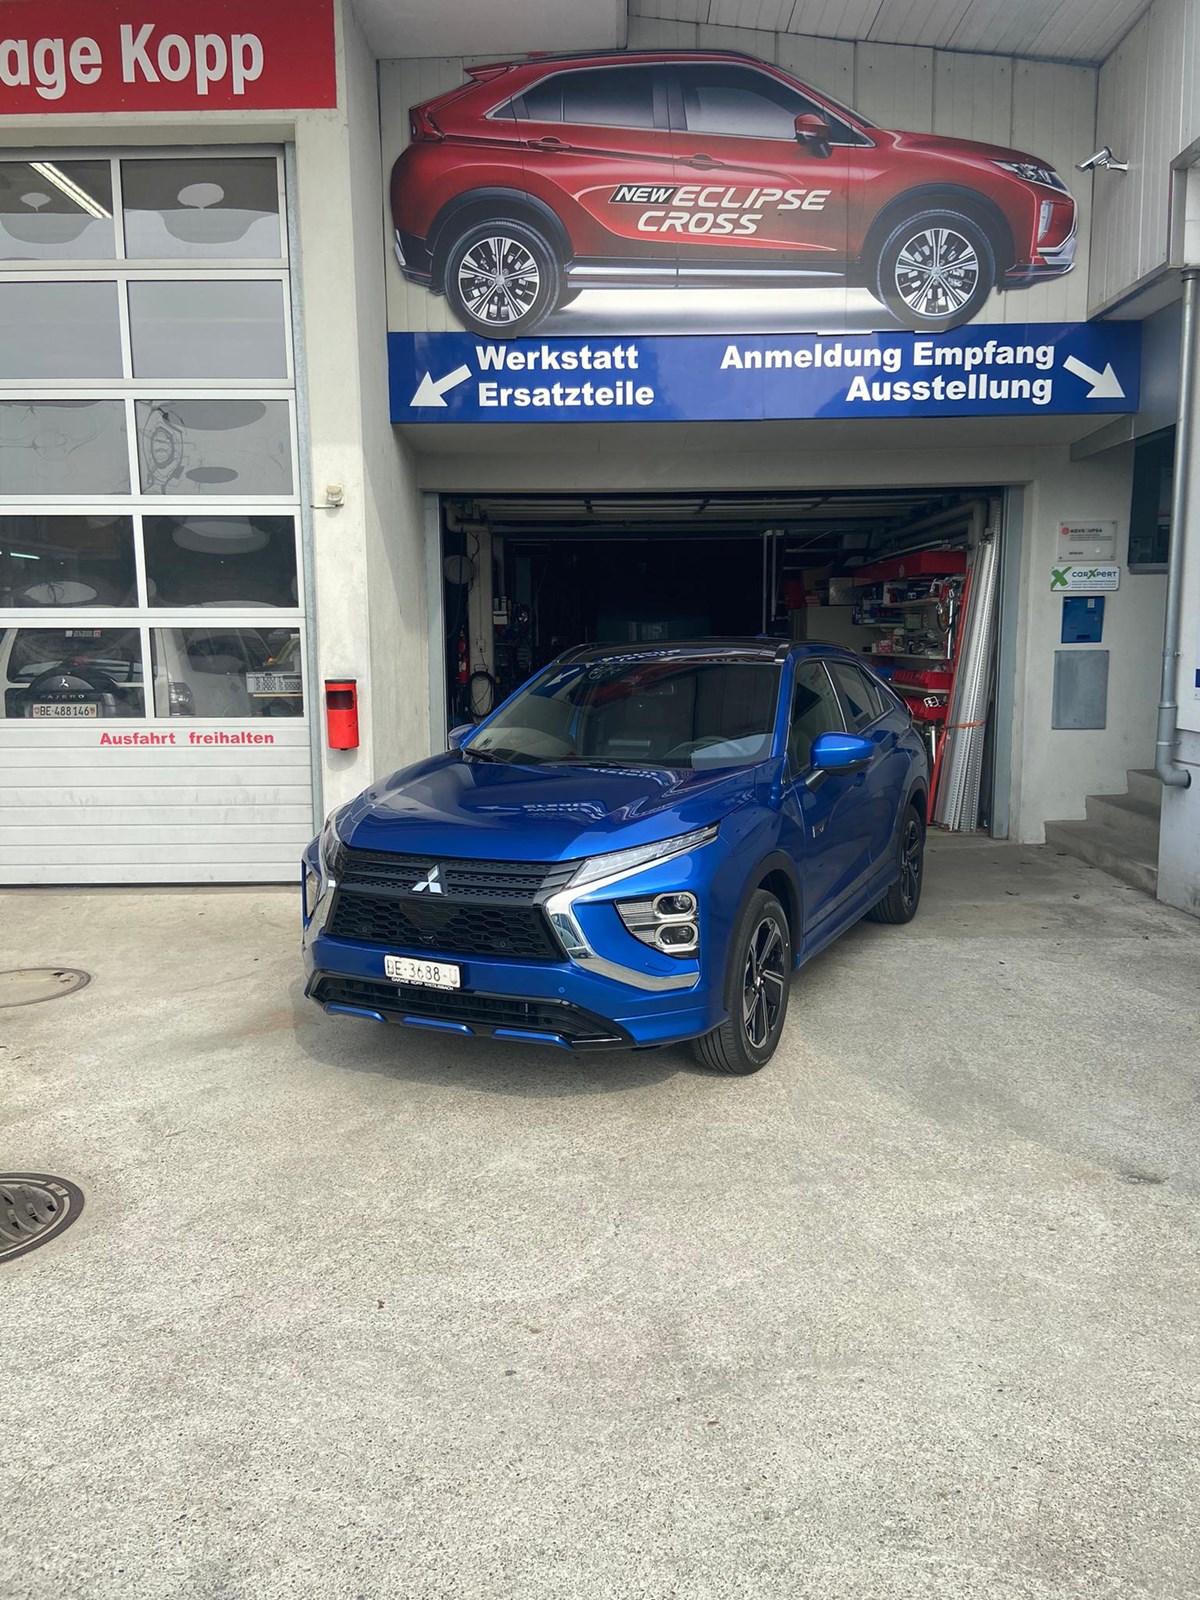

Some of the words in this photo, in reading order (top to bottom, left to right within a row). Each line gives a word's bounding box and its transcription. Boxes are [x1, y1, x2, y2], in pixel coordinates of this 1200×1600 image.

[119, 23, 264, 95] Kopp
[614, 187, 673, 202] NEW
[672, 186, 831, 211] ECLIPSE
[637, 211, 763, 235] CROSS
[476, 344, 639, 371] Werkstatt
[720, 343, 902, 372] Anmeldung
[913, 340, 1055, 371] Empfang
[478, 380, 655, 407] Ersatzteile
[845, 374, 1053, 405] Ausstellung
[99, 732, 176, 745] Ausfahrt
[189, 732, 274, 744] freihalten
